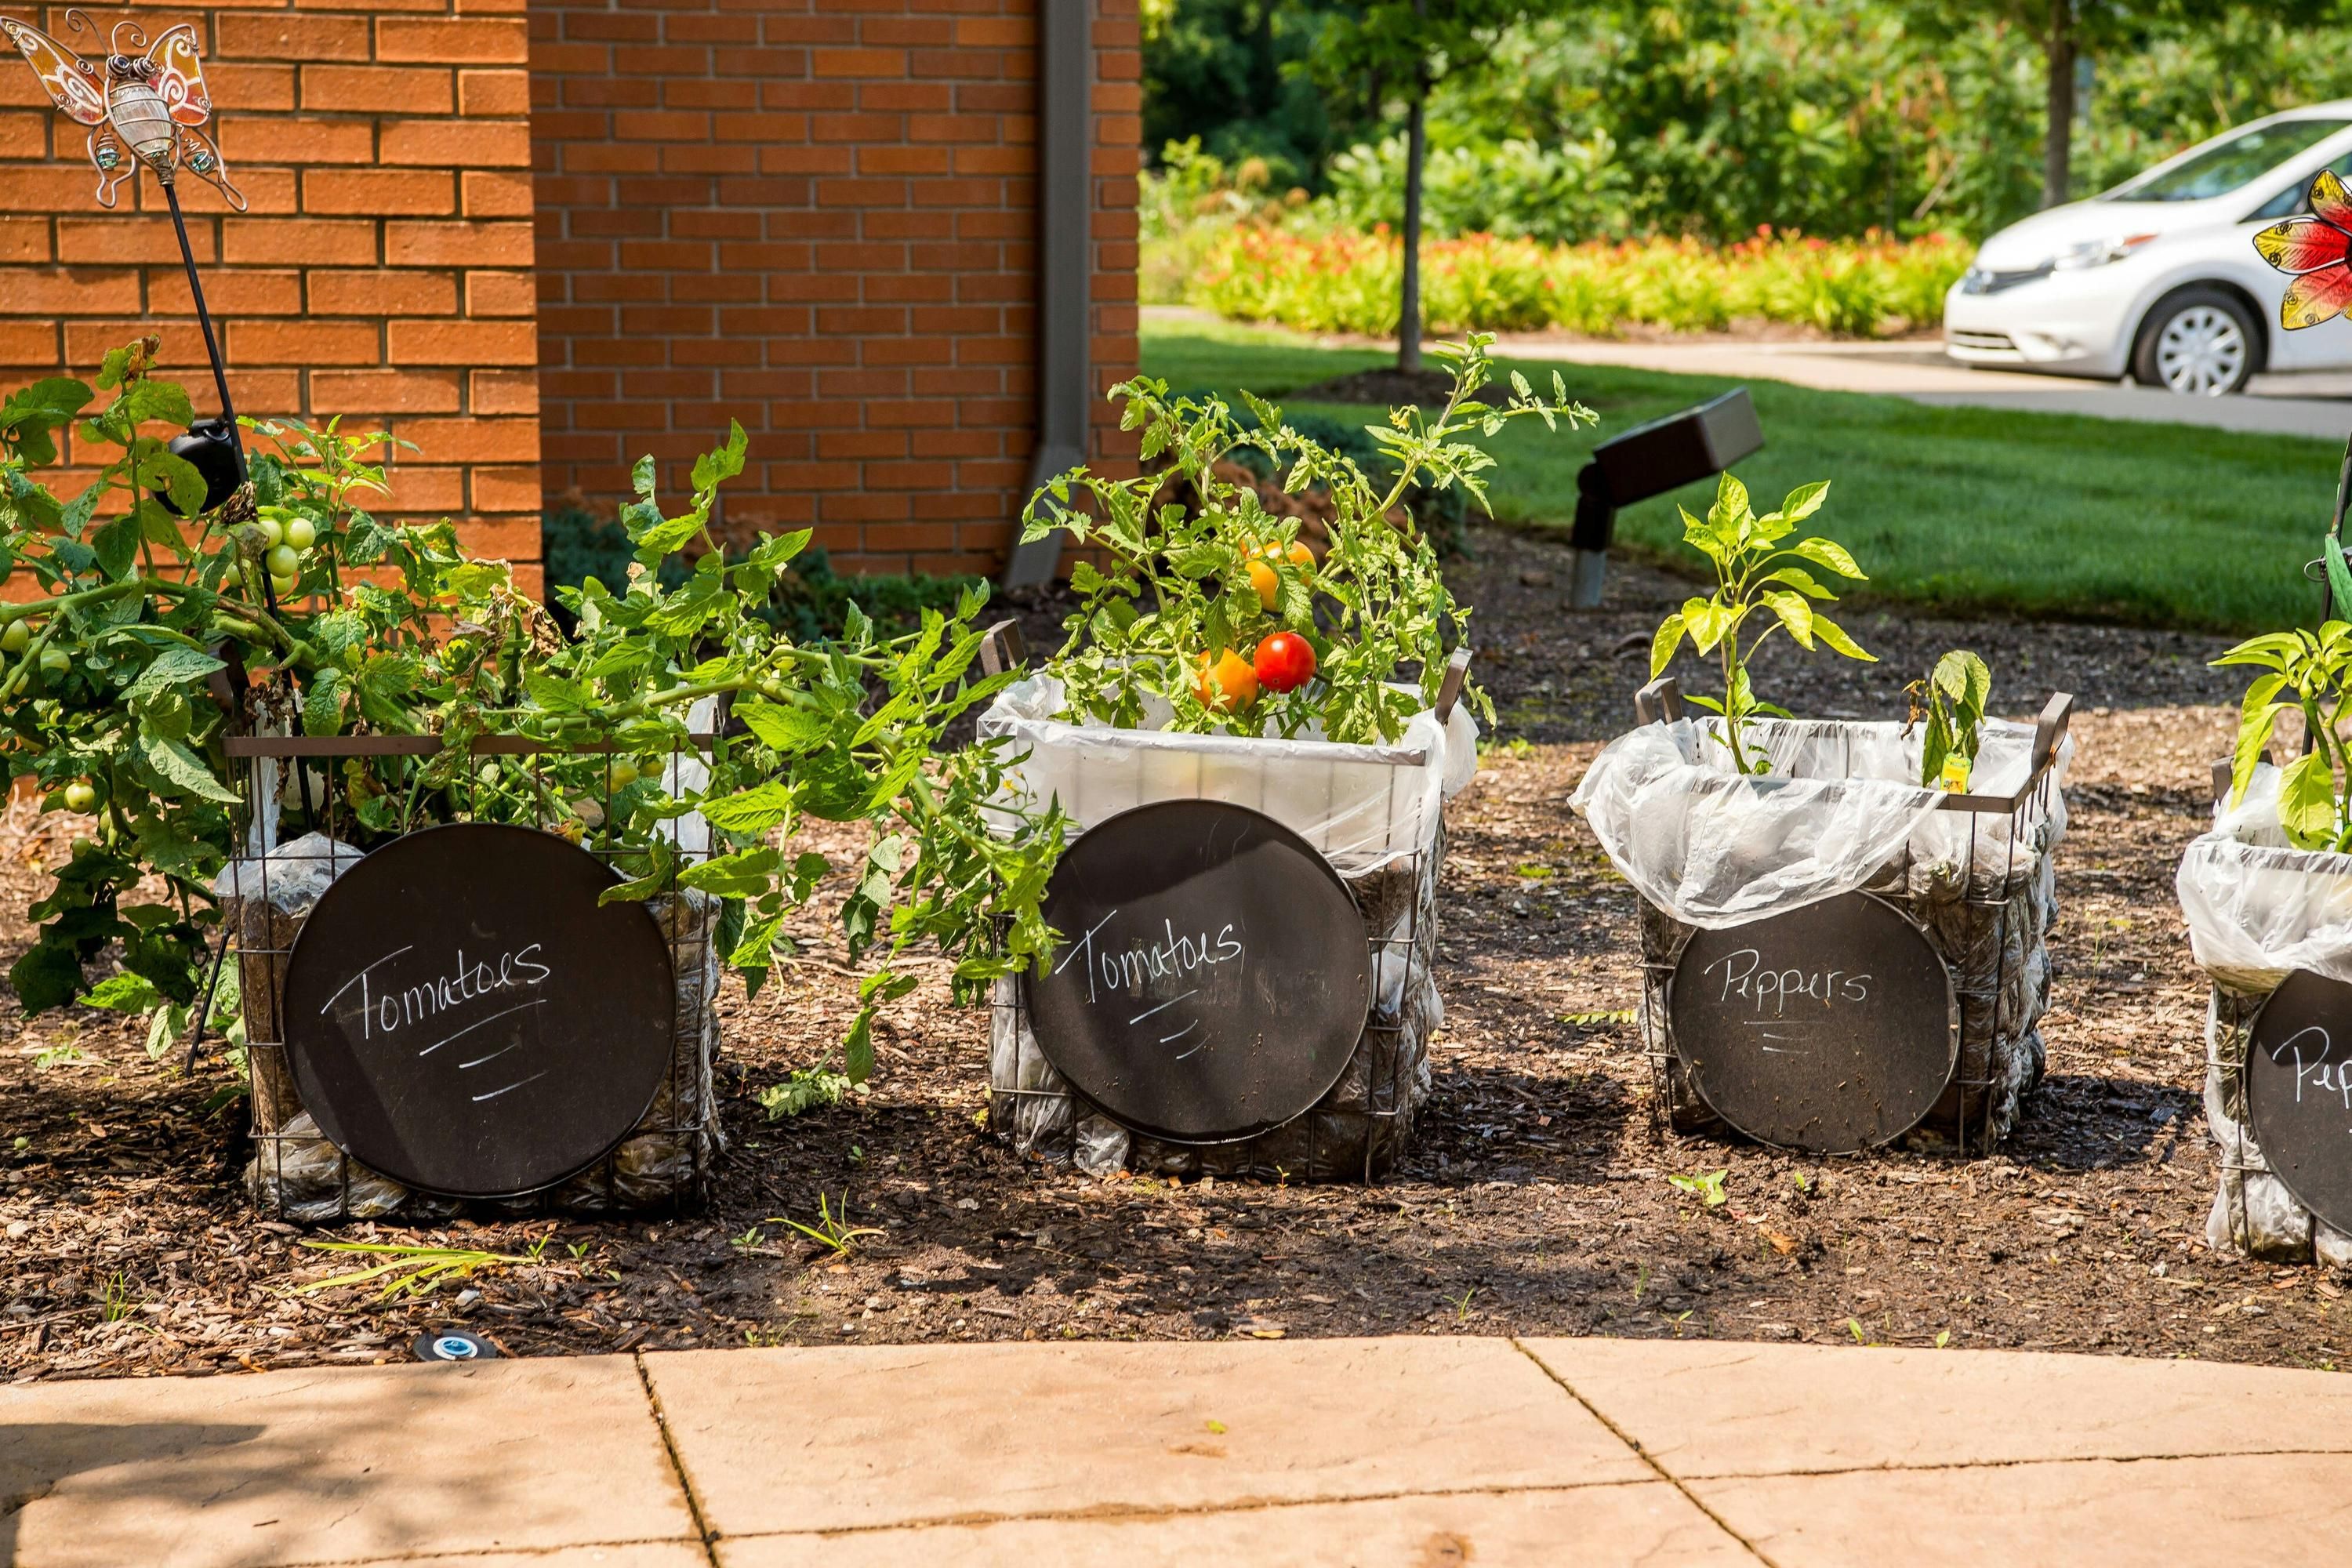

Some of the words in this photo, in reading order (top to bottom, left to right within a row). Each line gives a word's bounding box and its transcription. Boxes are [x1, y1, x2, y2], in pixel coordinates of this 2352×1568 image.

[320, 943, 550, 1040] Tomatoes
[1054, 909, 1242, 1004] Tomatoes
[1703, 948, 1872, 1013] Peppers
